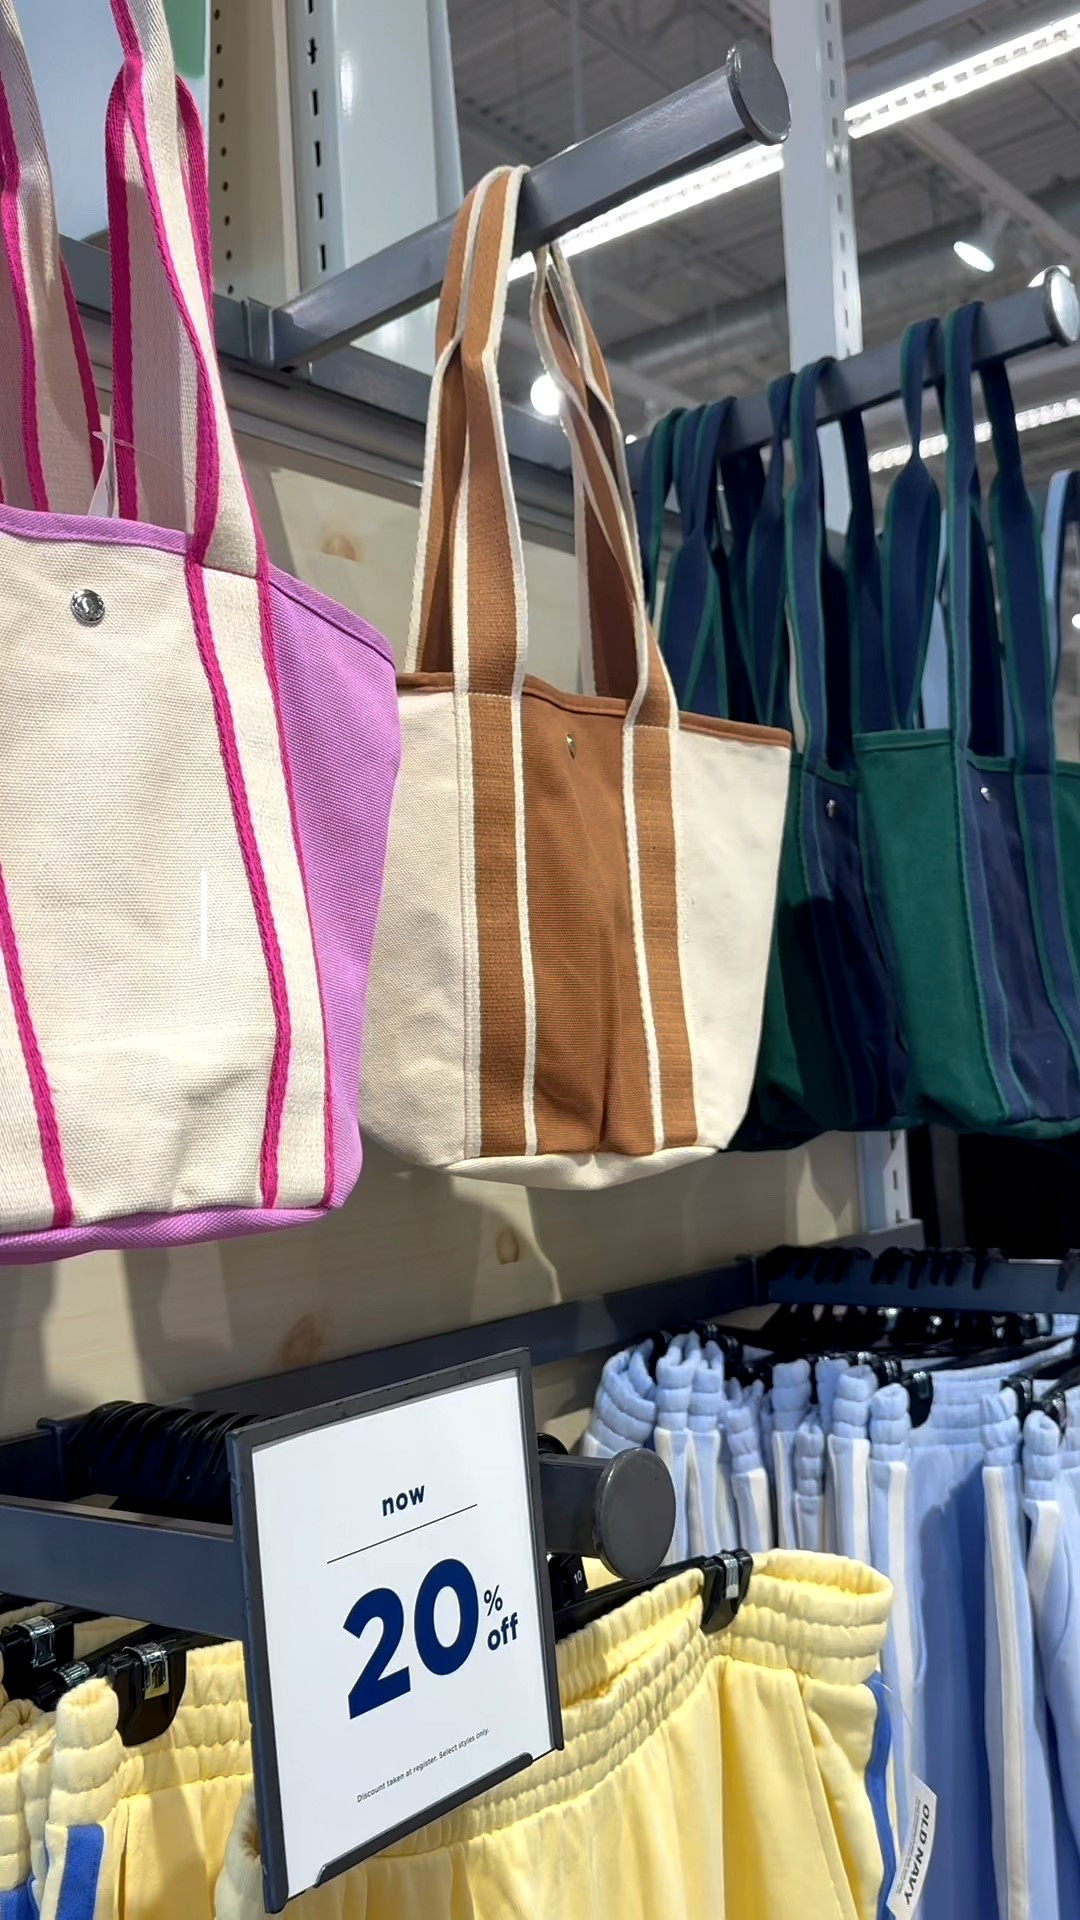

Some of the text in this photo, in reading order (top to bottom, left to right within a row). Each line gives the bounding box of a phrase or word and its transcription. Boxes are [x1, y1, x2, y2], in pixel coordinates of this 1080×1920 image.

[381, 1485, 425, 1516] now
[573, 1569, 583, 1584] 10
[343, 1558, 518, 1720] 20 % off
[357, 1728, 489, 1803] Discount taken at register. Select styles only.
[919, 1804, 930, 1845] OLD
[904, 1847, 924, 1905] NAVY
